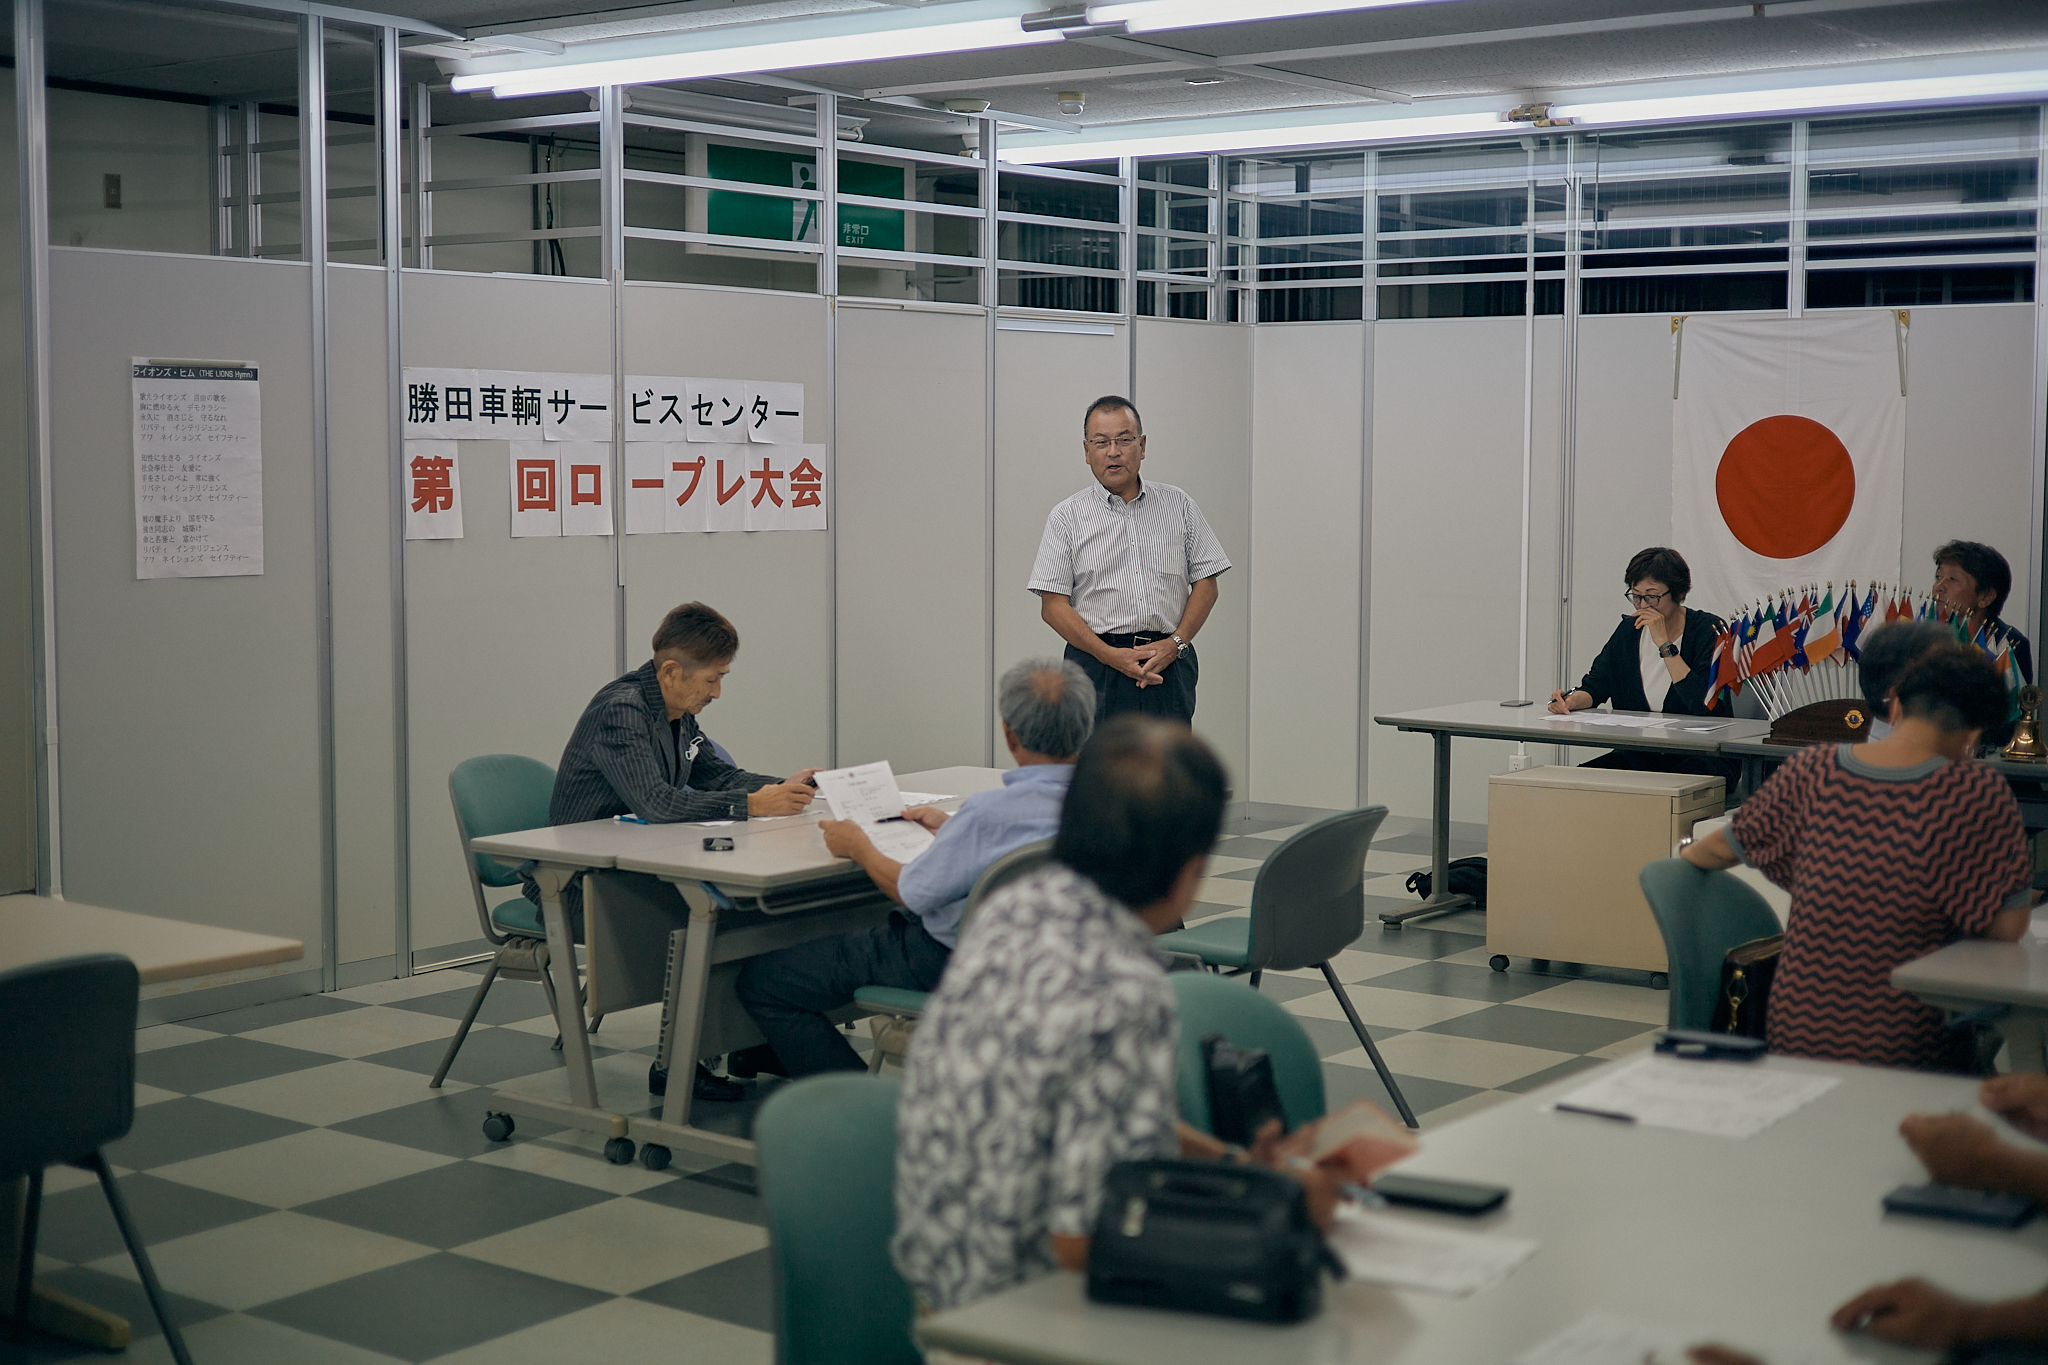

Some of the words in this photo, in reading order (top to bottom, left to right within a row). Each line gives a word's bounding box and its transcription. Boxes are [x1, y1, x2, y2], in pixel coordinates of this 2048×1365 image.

[843, 223, 869, 235] 非常口
[846, 236, 865, 244] EXIT
[215, 370, 234, 378] LIONS
[410, 455, 454, 514] 第
